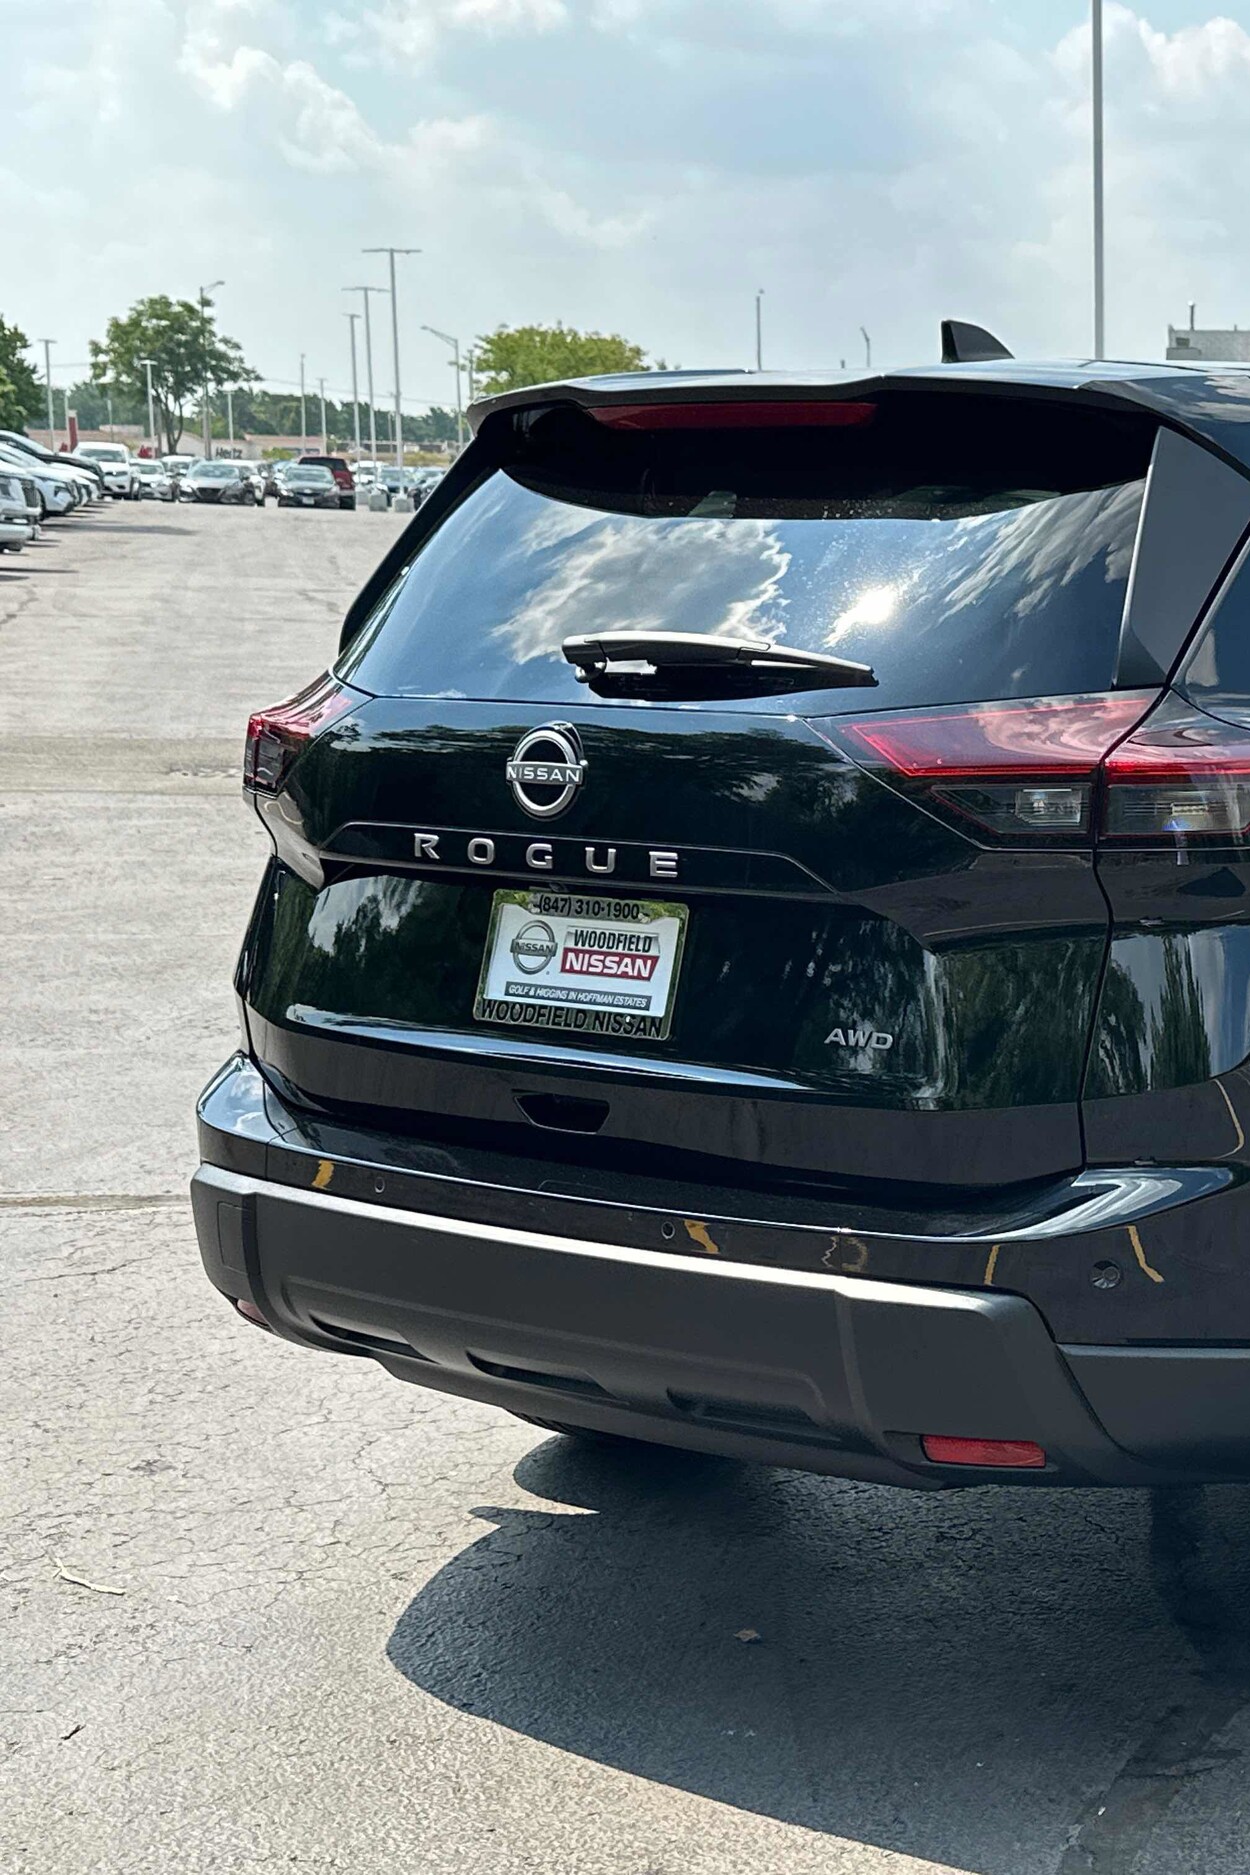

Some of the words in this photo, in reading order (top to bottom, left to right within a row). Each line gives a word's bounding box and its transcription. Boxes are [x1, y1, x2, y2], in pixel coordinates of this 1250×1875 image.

[215, 446, 243, 460] Hertz
[507, 765, 580, 783] NISSAN
[413, 832, 679, 878] ROGUE
[539, 894, 571, 916] (847)
[514, 942, 554, 953] NISSAN
[573, 929, 653, 953] WOODFIELD
[564, 952, 652, 977] NISSAN
[508, 984, 530, 994] GOLF
[535, 986, 567, 999] HIGGINS
[567, 990, 577, 1000] IN
[577, 992, 614, 1004] HOFFMAN
[614, 996, 648, 1008] ESTATES
[480, 1000, 587, 1029] WOODFIELD
[592, 1011, 663, 1039] NISSAN
[823, 1027, 894, 1050] AWD
